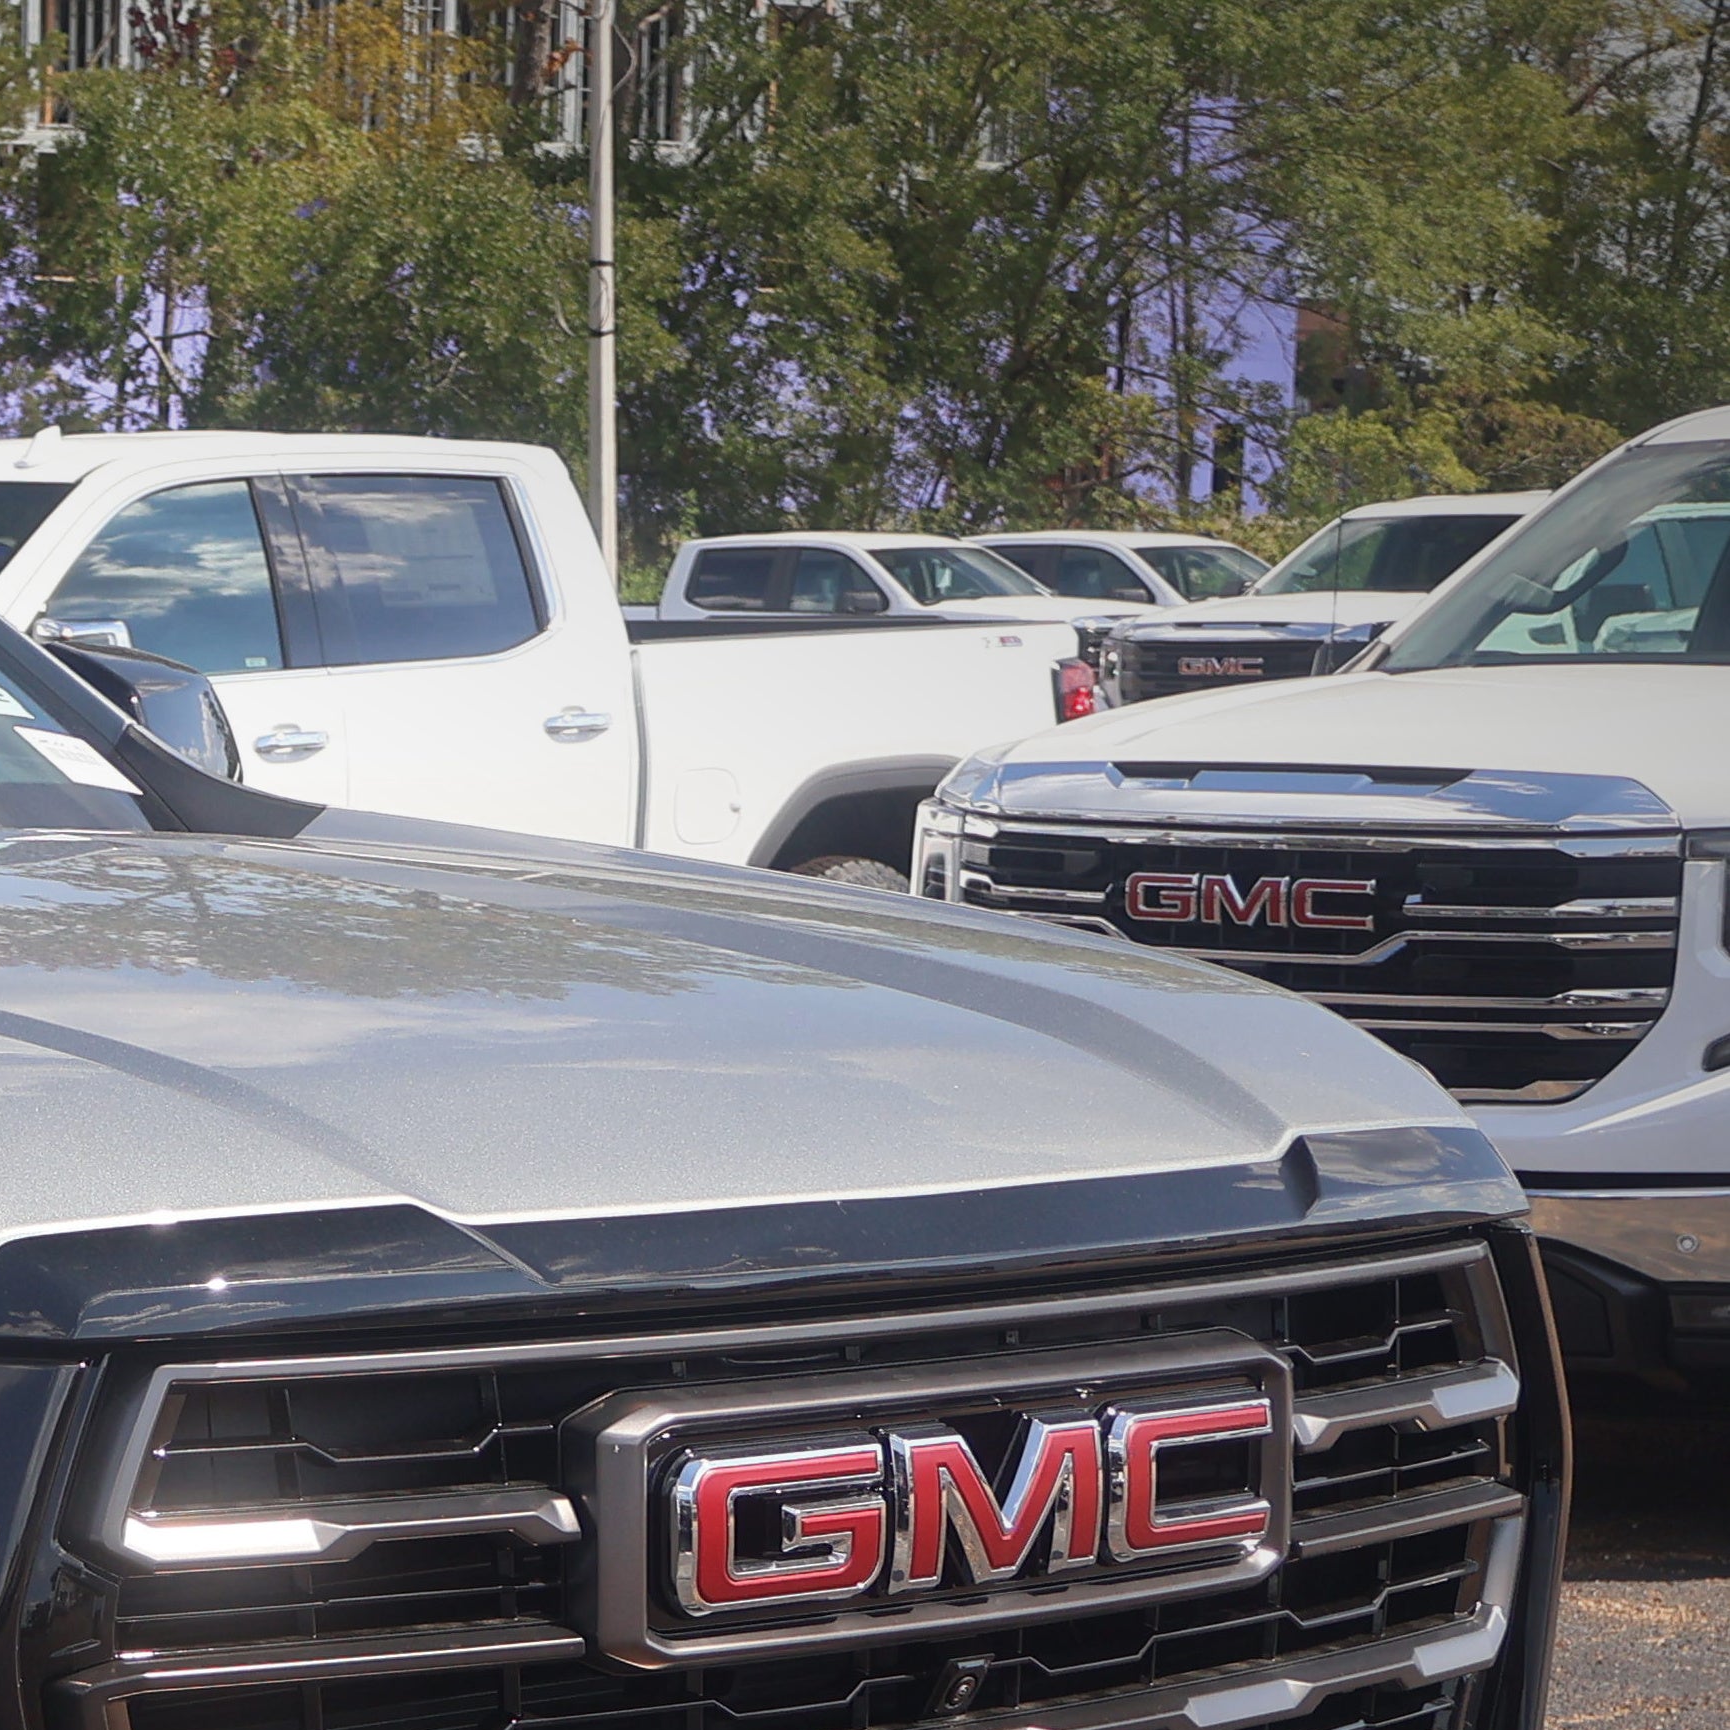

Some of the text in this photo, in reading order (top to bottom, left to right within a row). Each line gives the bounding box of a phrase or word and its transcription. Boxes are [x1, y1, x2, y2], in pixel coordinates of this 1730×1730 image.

[1178, 656, 1264, 676] GMC
[1126, 871, 1377, 932] GMC
[673, 1396, 1273, 1619] GMC
